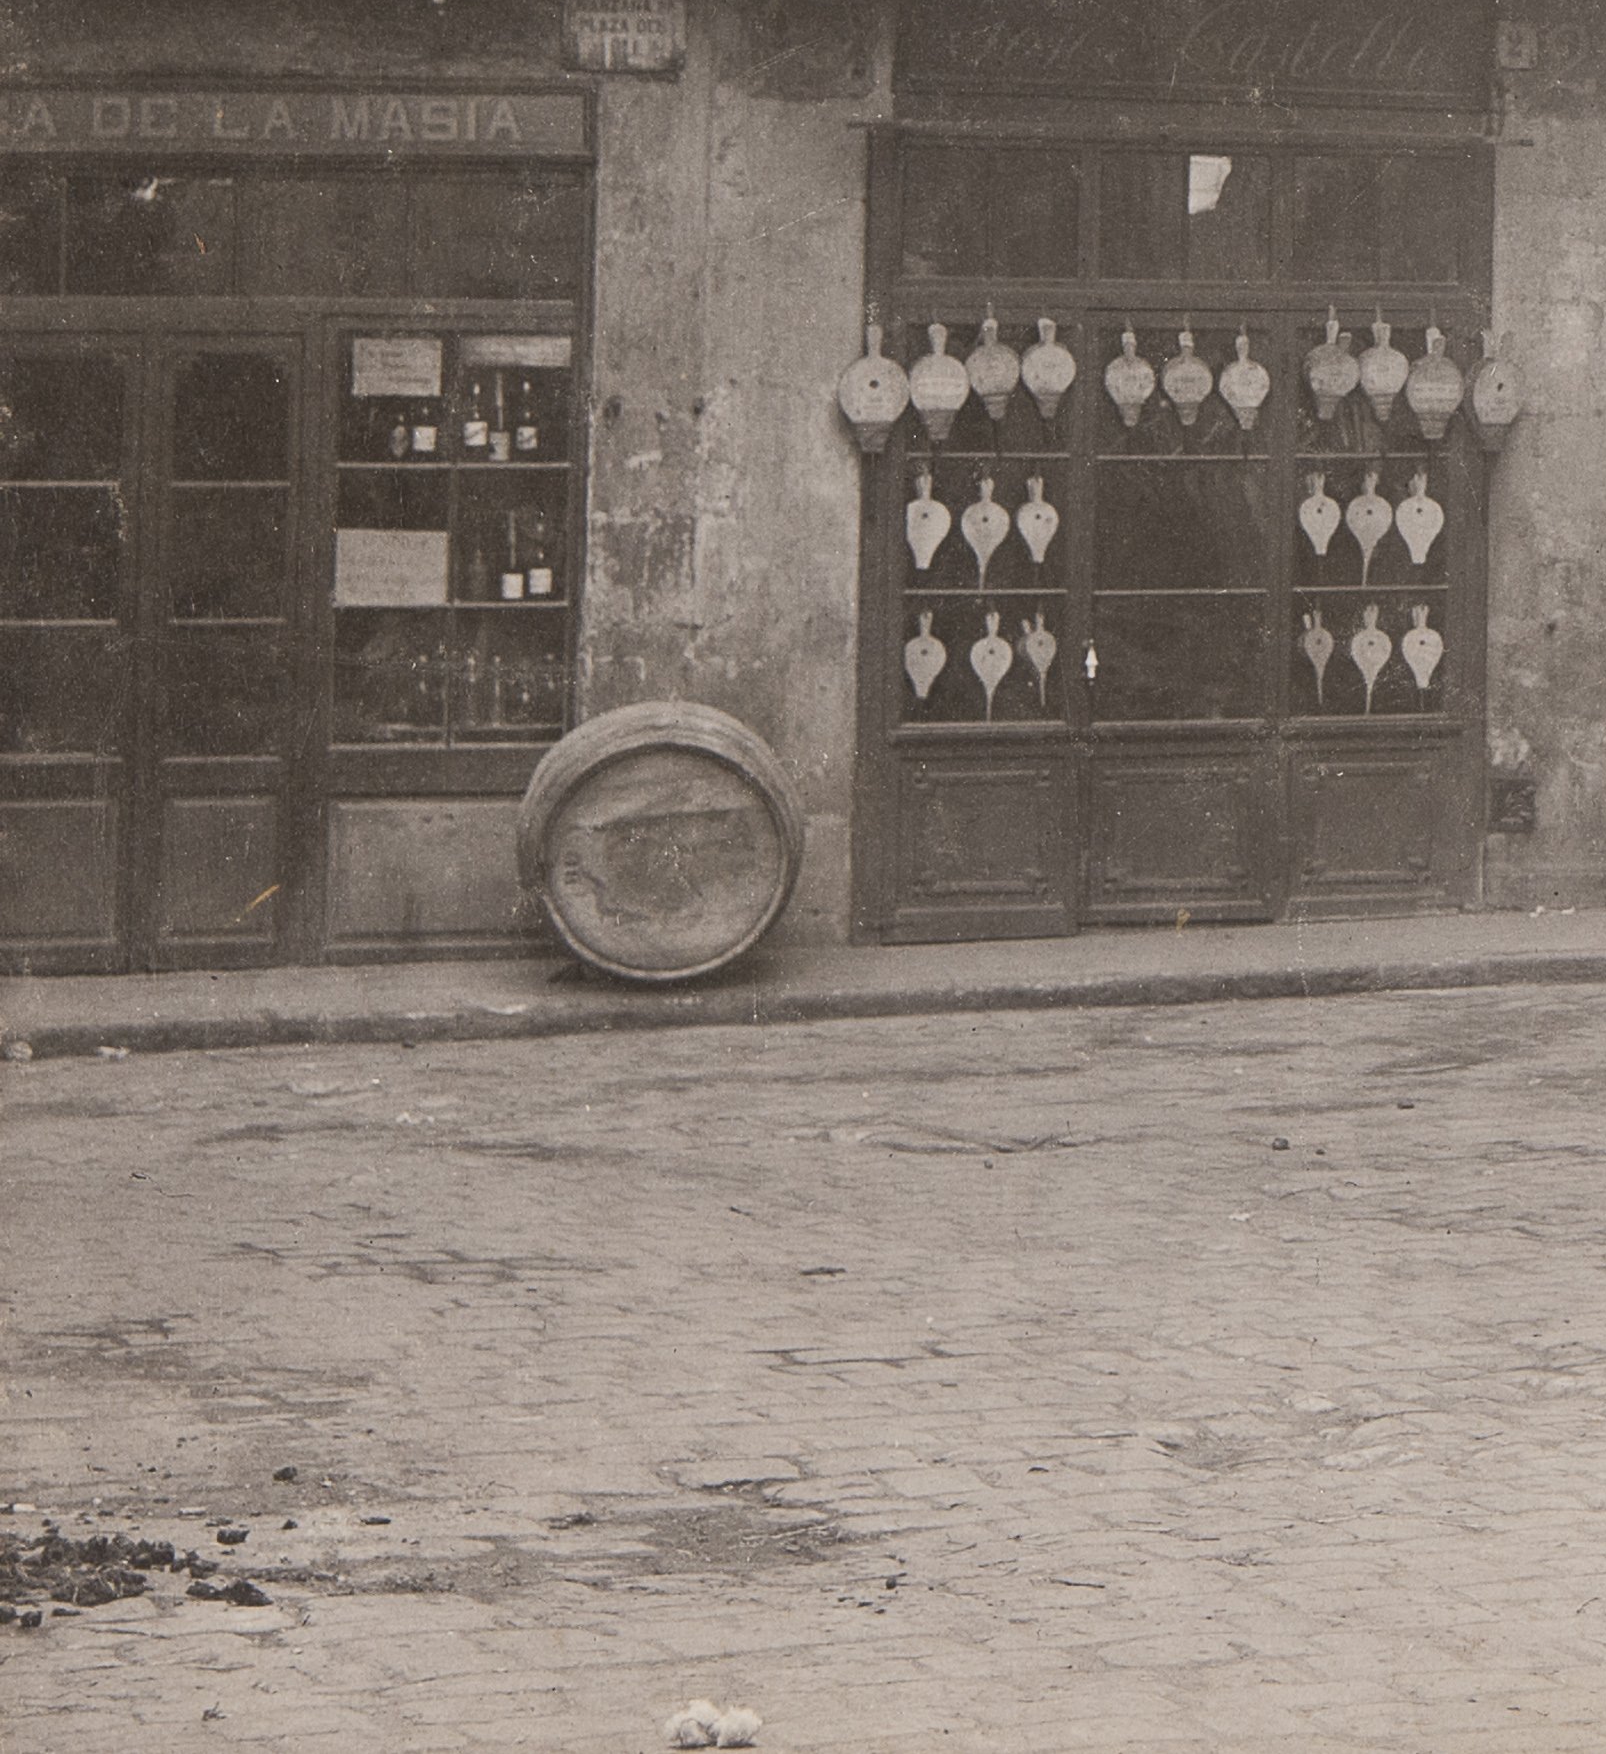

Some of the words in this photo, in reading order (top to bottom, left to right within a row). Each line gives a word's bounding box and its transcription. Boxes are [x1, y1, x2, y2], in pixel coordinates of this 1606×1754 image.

[90, 96, 179, 139] DE
[213, 97, 299, 141] LA
[330, 96, 524, 142] MASIA
